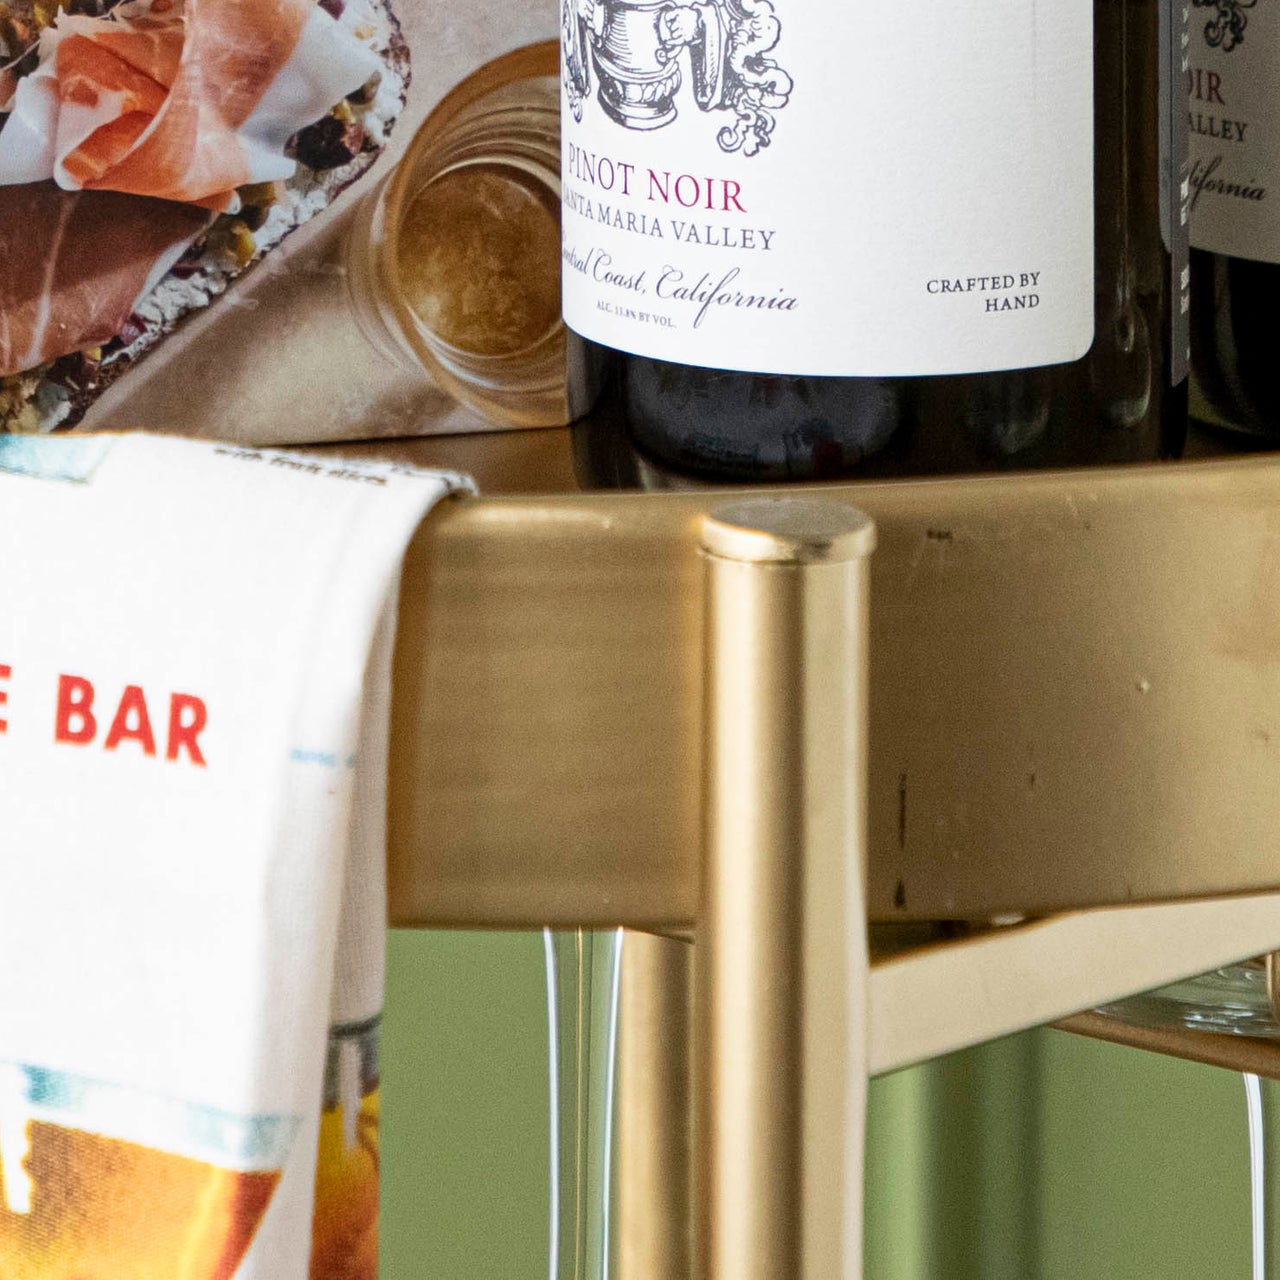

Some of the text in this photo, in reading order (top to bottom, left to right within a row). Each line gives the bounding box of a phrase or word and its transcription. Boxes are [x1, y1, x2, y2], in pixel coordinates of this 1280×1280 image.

[1188, 68, 1225, 105] IR
[569, 140, 748, 213] PINOT NOIR
[563, 184, 777, 251] ANTA MARIA VALLEY
[593, 248, 646, 295] Coast,
[655, 265, 799, 329] California
[926, 271, 1040, 294] CRAFTED BY
[985, 294, 1040, 312] HAND
[639, 312, 650, 322] BY
[53, 672, 208, 768] BAR
